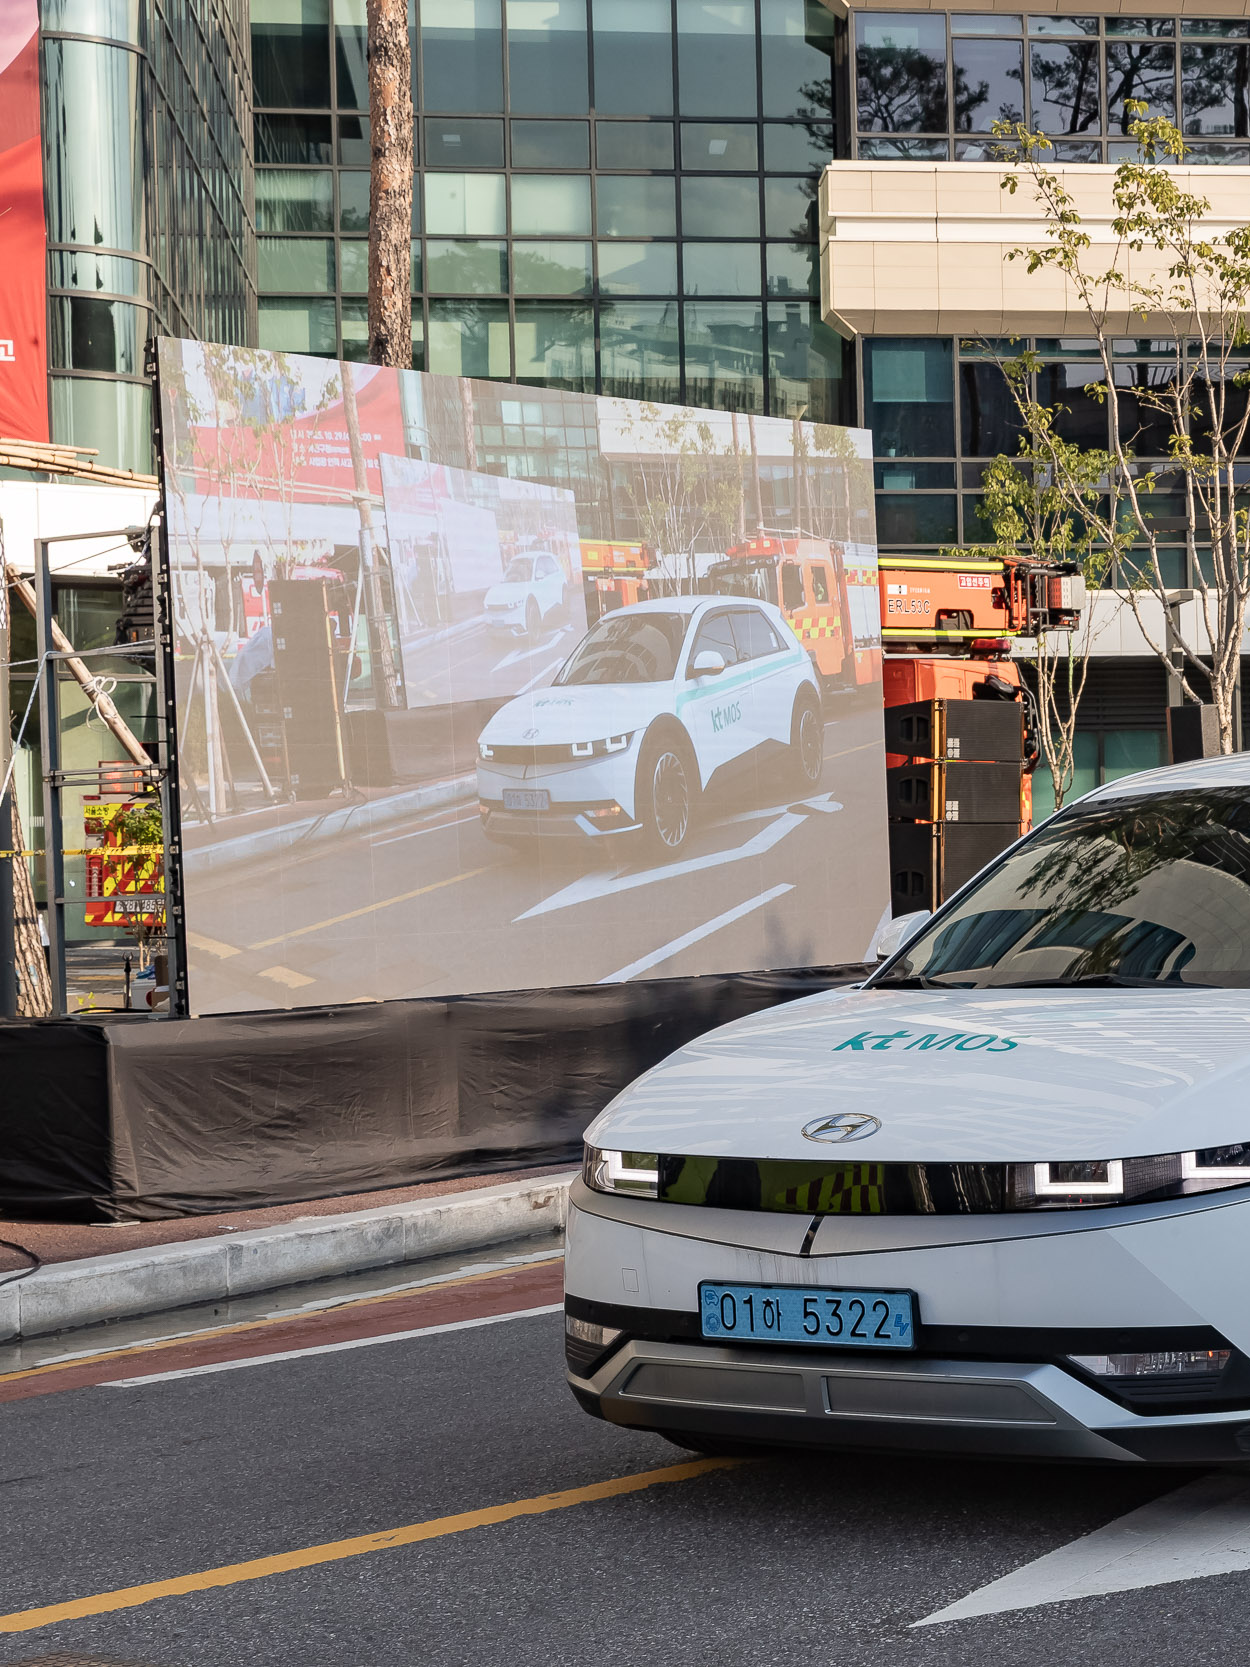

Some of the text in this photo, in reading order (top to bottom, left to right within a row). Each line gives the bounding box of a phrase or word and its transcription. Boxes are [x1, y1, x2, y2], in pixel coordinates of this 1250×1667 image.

[960, 577, 990, 588] 고압선주의
[888, 599, 930, 614] ERL53C
[710, 701, 742, 733] kt MOS
[84, 806, 110, 816] 서울소방
[831, 1030, 1033, 1052] kt MOS
[720, 1292, 783, 1332] 01하
[803, 1297, 891, 1339] 5322
